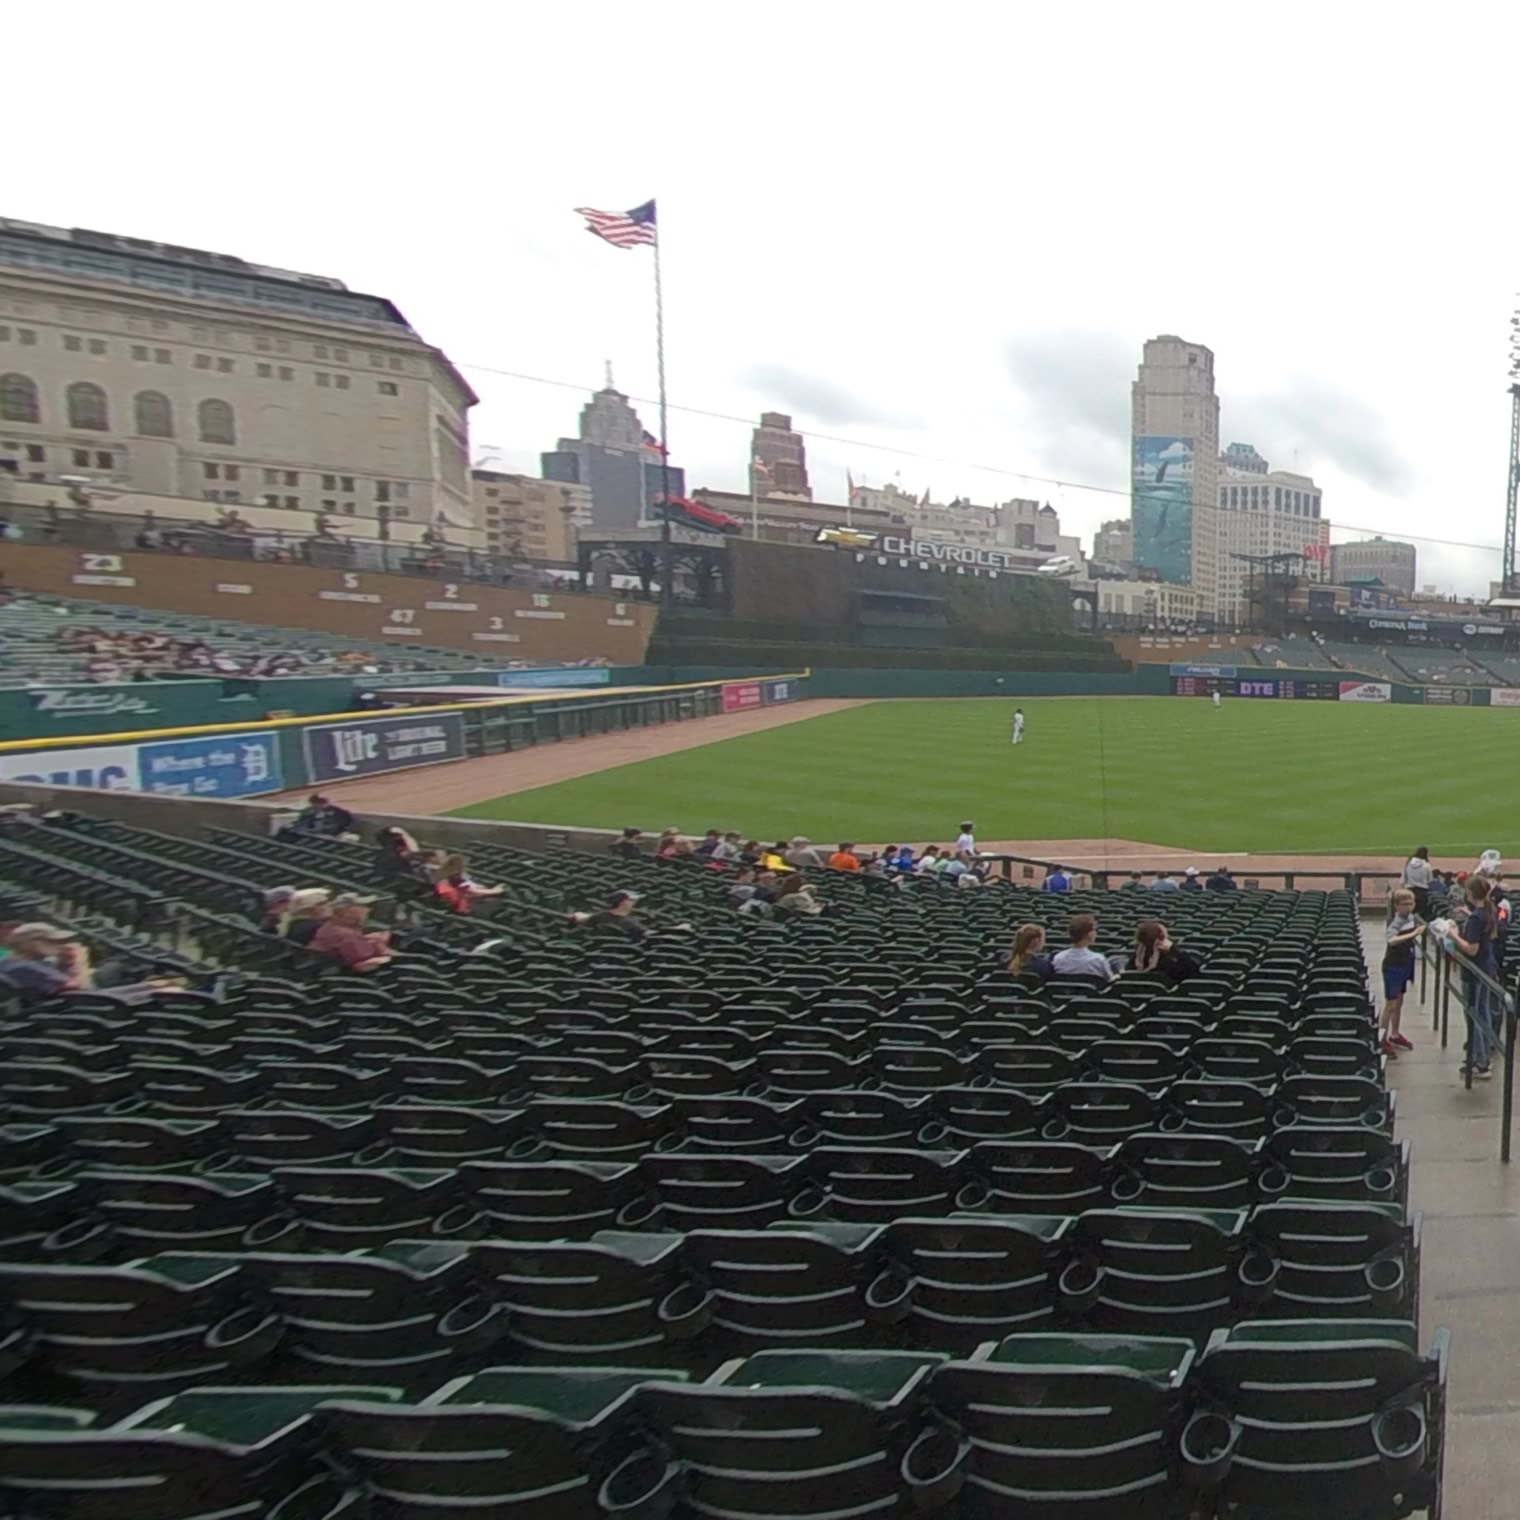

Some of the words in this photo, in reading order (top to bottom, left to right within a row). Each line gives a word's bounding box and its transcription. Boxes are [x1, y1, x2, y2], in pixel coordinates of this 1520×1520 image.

[883, 536, 1012, 568] CHEVROLET
[344, 572, 359, 588] 5
[444, 584, 459, 598] 2
[489, 616, 503, 630] 3
[1240, 681, 1274, 696] DTE
[331, 729, 379, 771] Lite
